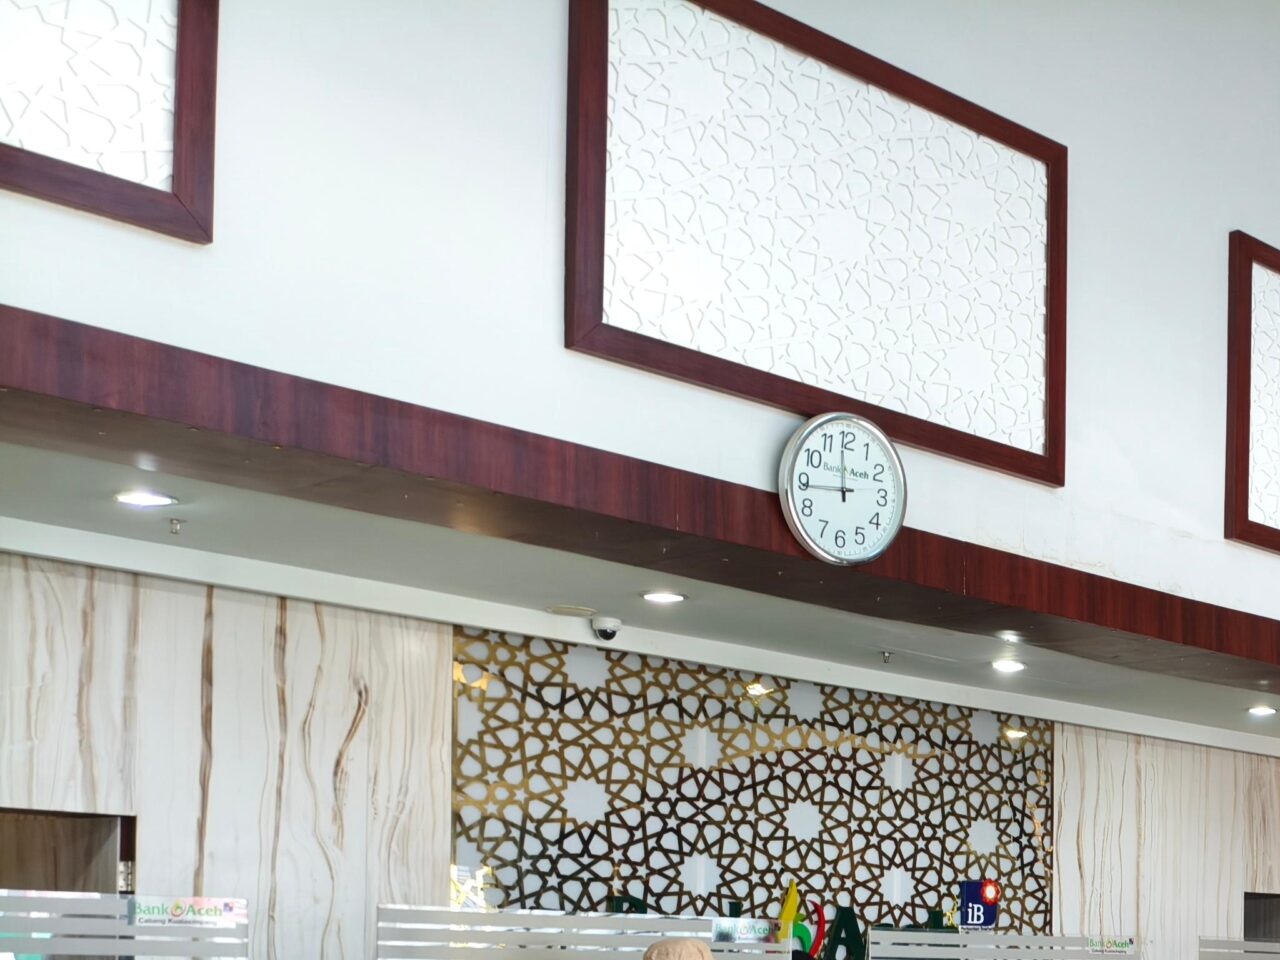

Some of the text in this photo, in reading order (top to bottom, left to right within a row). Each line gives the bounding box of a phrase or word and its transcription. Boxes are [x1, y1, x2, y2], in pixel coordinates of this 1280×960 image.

[821, 433, 834, 453] 11
[839, 430, 856, 452] 12
[804, 448, 822, 469] 10
[863, 442, 870, 461] 1
[798, 472, 810, 491] 9
[849, 466, 869, 480] Aceh
[873, 463, 885, 483] 2
[876, 488, 888, 507] 3
[801, 498, 813, 517] 8
[818, 519, 829, 538] 7
[869, 512, 881, 530] 4
[834, 530, 846, 548] 6
[854, 526, 865, 545] 5
[134, 902, 223, 917] Bank Aceh
[967, 902, 985, 924] iB
